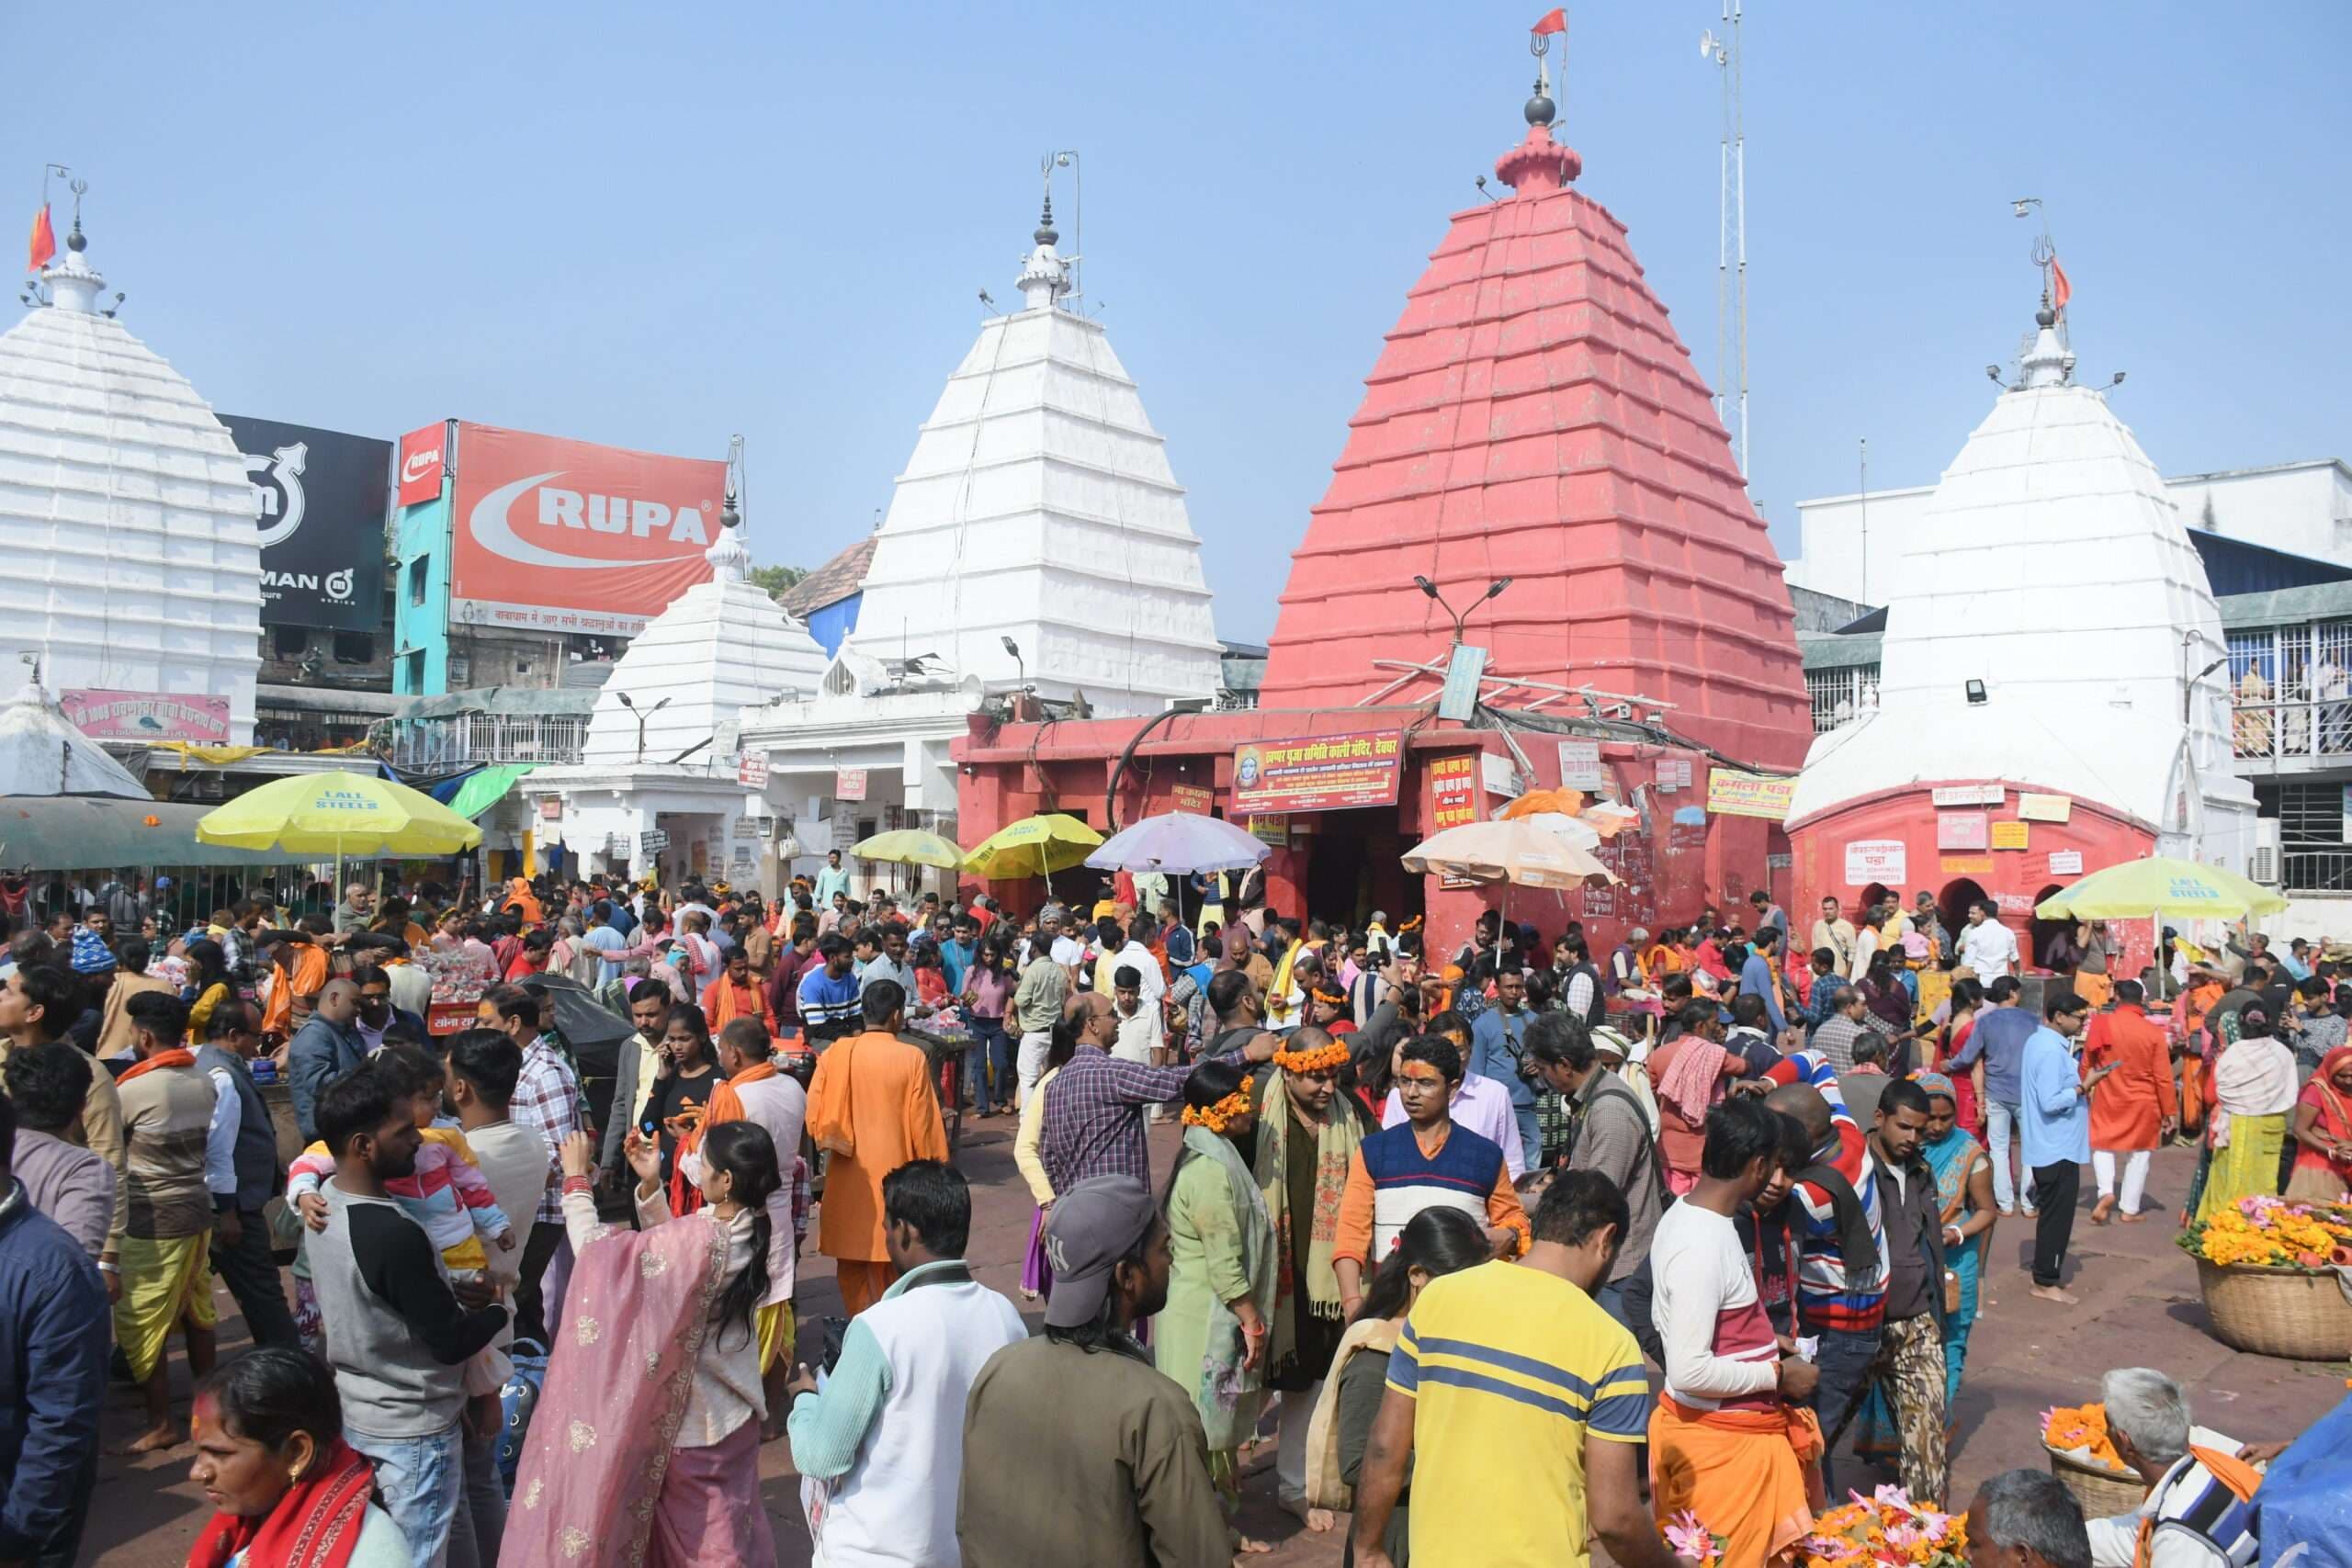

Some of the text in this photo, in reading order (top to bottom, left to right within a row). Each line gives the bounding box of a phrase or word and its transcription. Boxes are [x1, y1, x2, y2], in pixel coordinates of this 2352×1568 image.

[411, 449, 438, 469] RUPA
[538, 487, 709, 546] RUPA
[316, 801, 379, 809] STEELS
